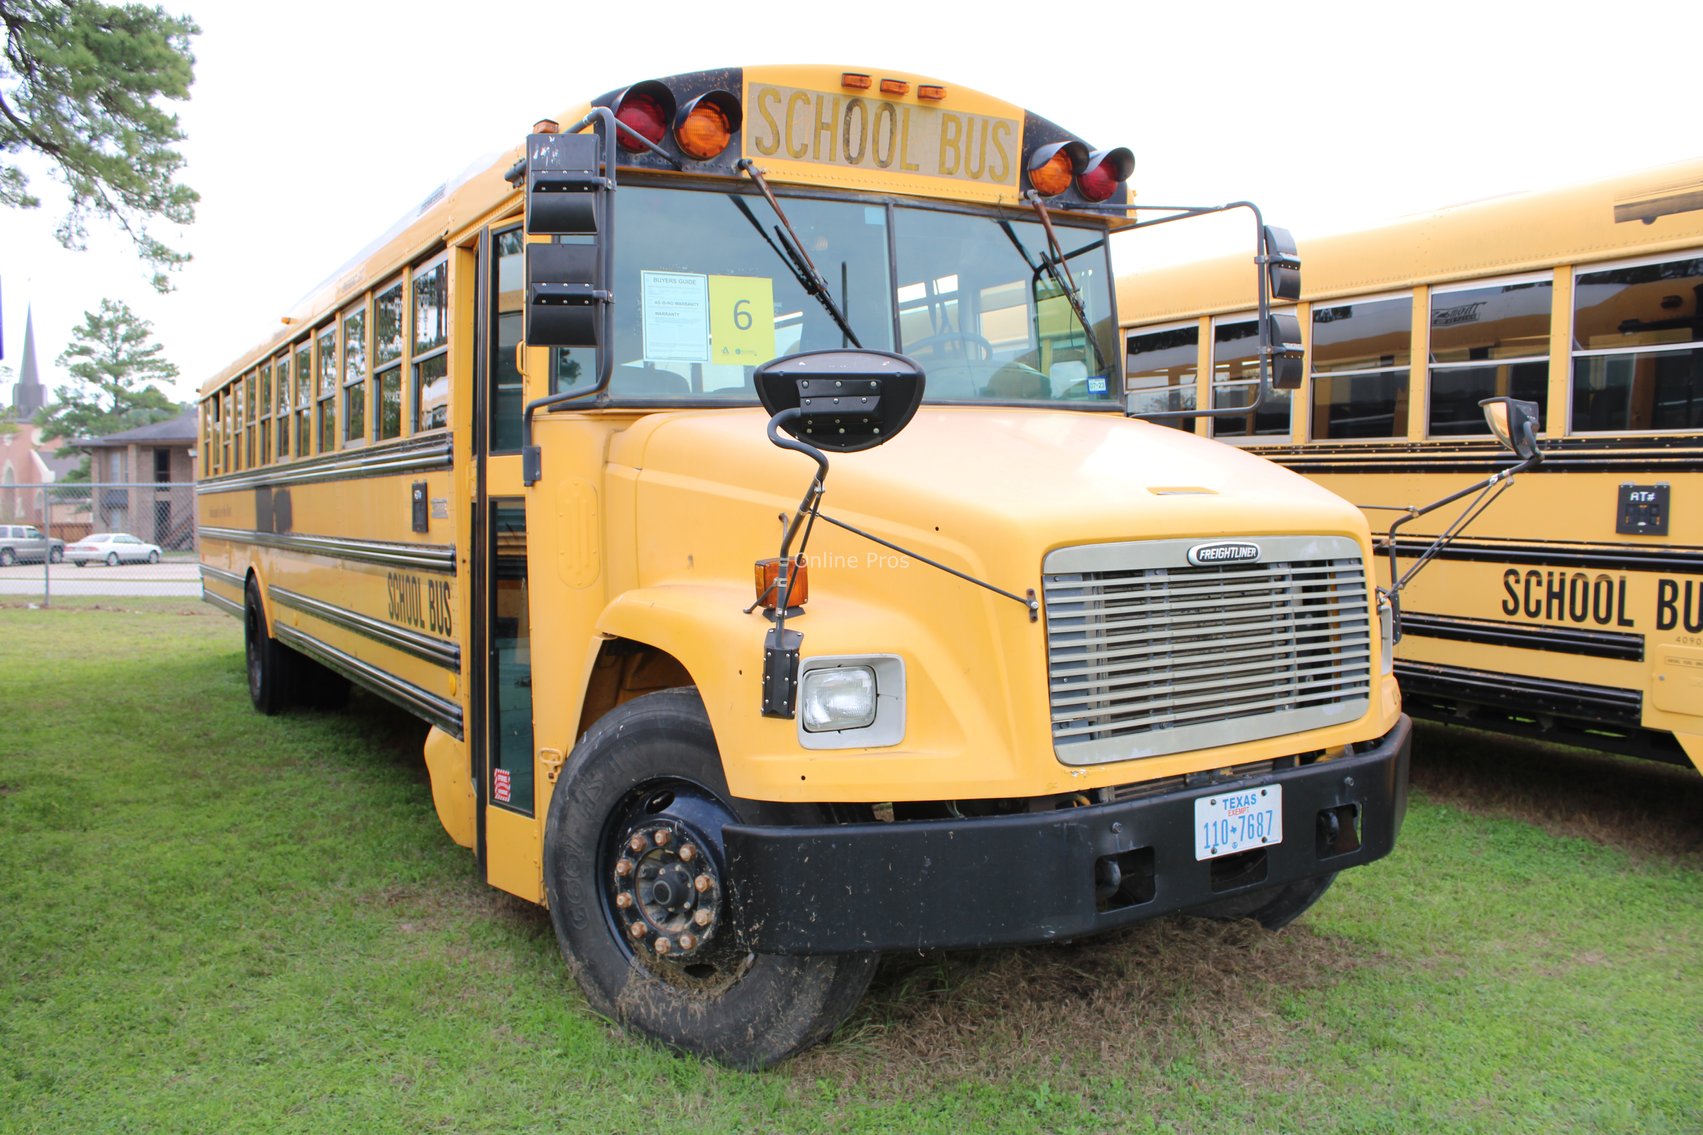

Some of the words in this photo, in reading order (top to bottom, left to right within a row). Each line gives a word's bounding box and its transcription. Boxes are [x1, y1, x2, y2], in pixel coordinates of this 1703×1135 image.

[755, 87, 919, 171] SCHOOL
[938, 113, 1011, 182] BUS
[678, 278, 697, 286] GUIDE
[733, 299, 753, 331] 6
[1199, 547, 1257, 560] FREIGHTLINER
[387, 571, 425, 630] SCHOOL
[428, 579, 453, 637] BUS
[1501, 568, 1635, 628] SCHOOL
[1222, 793, 1257, 811] TEXAS
[1227, 806, 1250, 817] EXEMPT
